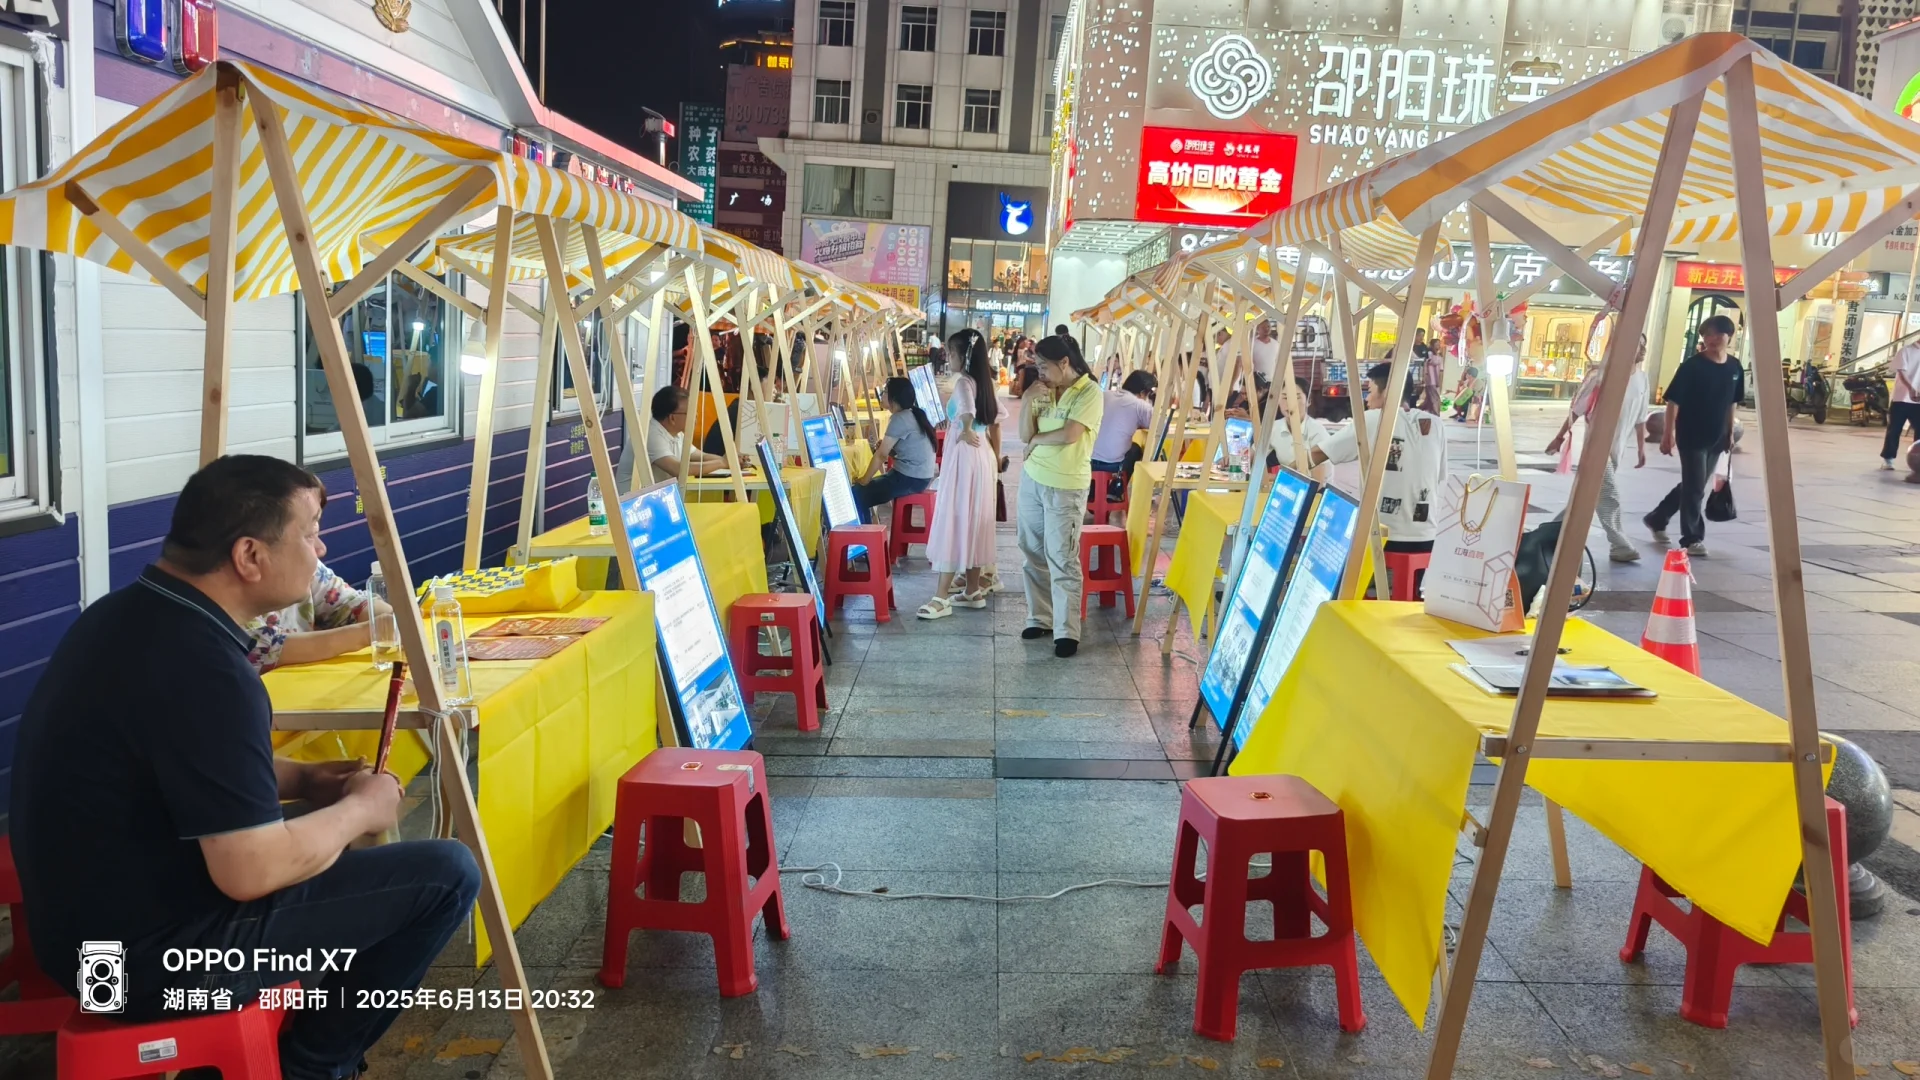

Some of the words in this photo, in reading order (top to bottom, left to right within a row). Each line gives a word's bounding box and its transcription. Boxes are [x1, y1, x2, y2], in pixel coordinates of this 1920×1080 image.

[1375, 127, 1429, 149] YANG
[1148, 160, 1283, 194] 高价回收黄金
[1891, 225, 1919, 237] 金加工
[976, 299, 1001, 311] luckin
[1002, 301, 1029, 314] coffee
